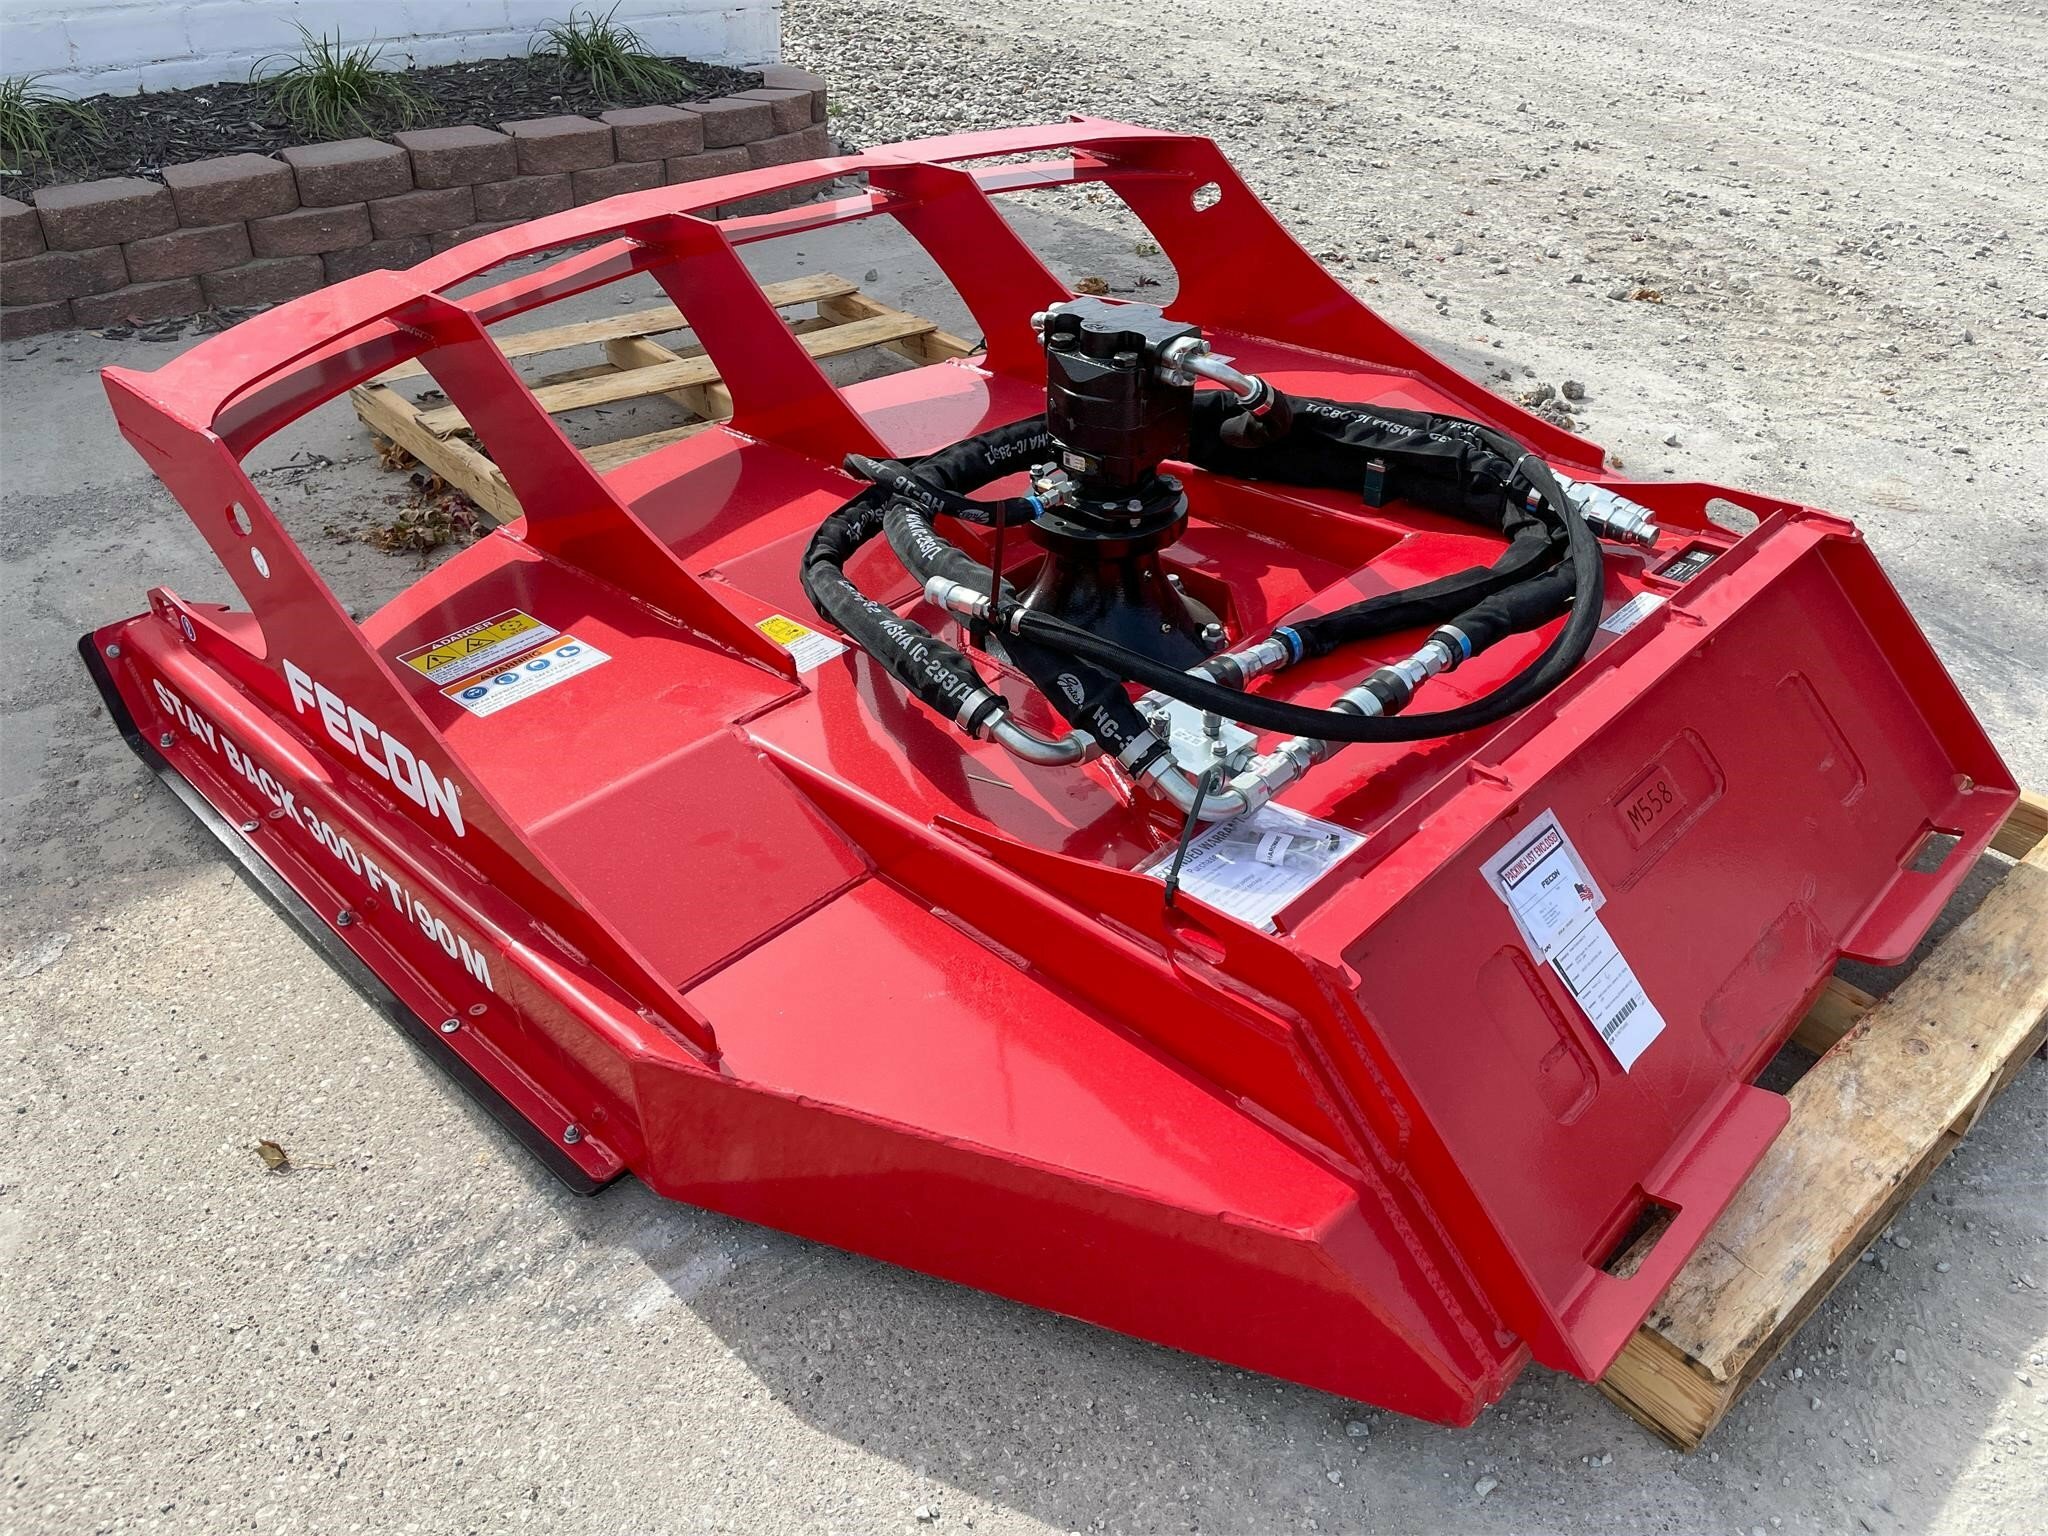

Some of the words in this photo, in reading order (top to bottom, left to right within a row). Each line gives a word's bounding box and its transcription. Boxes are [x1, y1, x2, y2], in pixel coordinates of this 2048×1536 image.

[893, 475, 945, 512] HG-16
[440, 620, 494, 646] DANGER
[486, 649, 544, 677] WARNING
[878, 619, 914, 651] MSHA
[909, 642, 975, 702] IC-293/1
[1057, 673, 1085, 706] Gates
[283, 658, 465, 837] FECON
[153, 678, 219, 754] STAY
[220, 733, 306, 830] BACK
[303, 806, 362, 876] 300
[1626, 780, 1672, 832] M558
[1154, 848, 1203, 879] EXTNDED
[1504, 859, 1528, 882] PACKING
[1524, 849, 1536, 867] LIST
[1534, 831, 1559, 858] ENCLOSED
[1541, 868, 1560, 889] FECON
